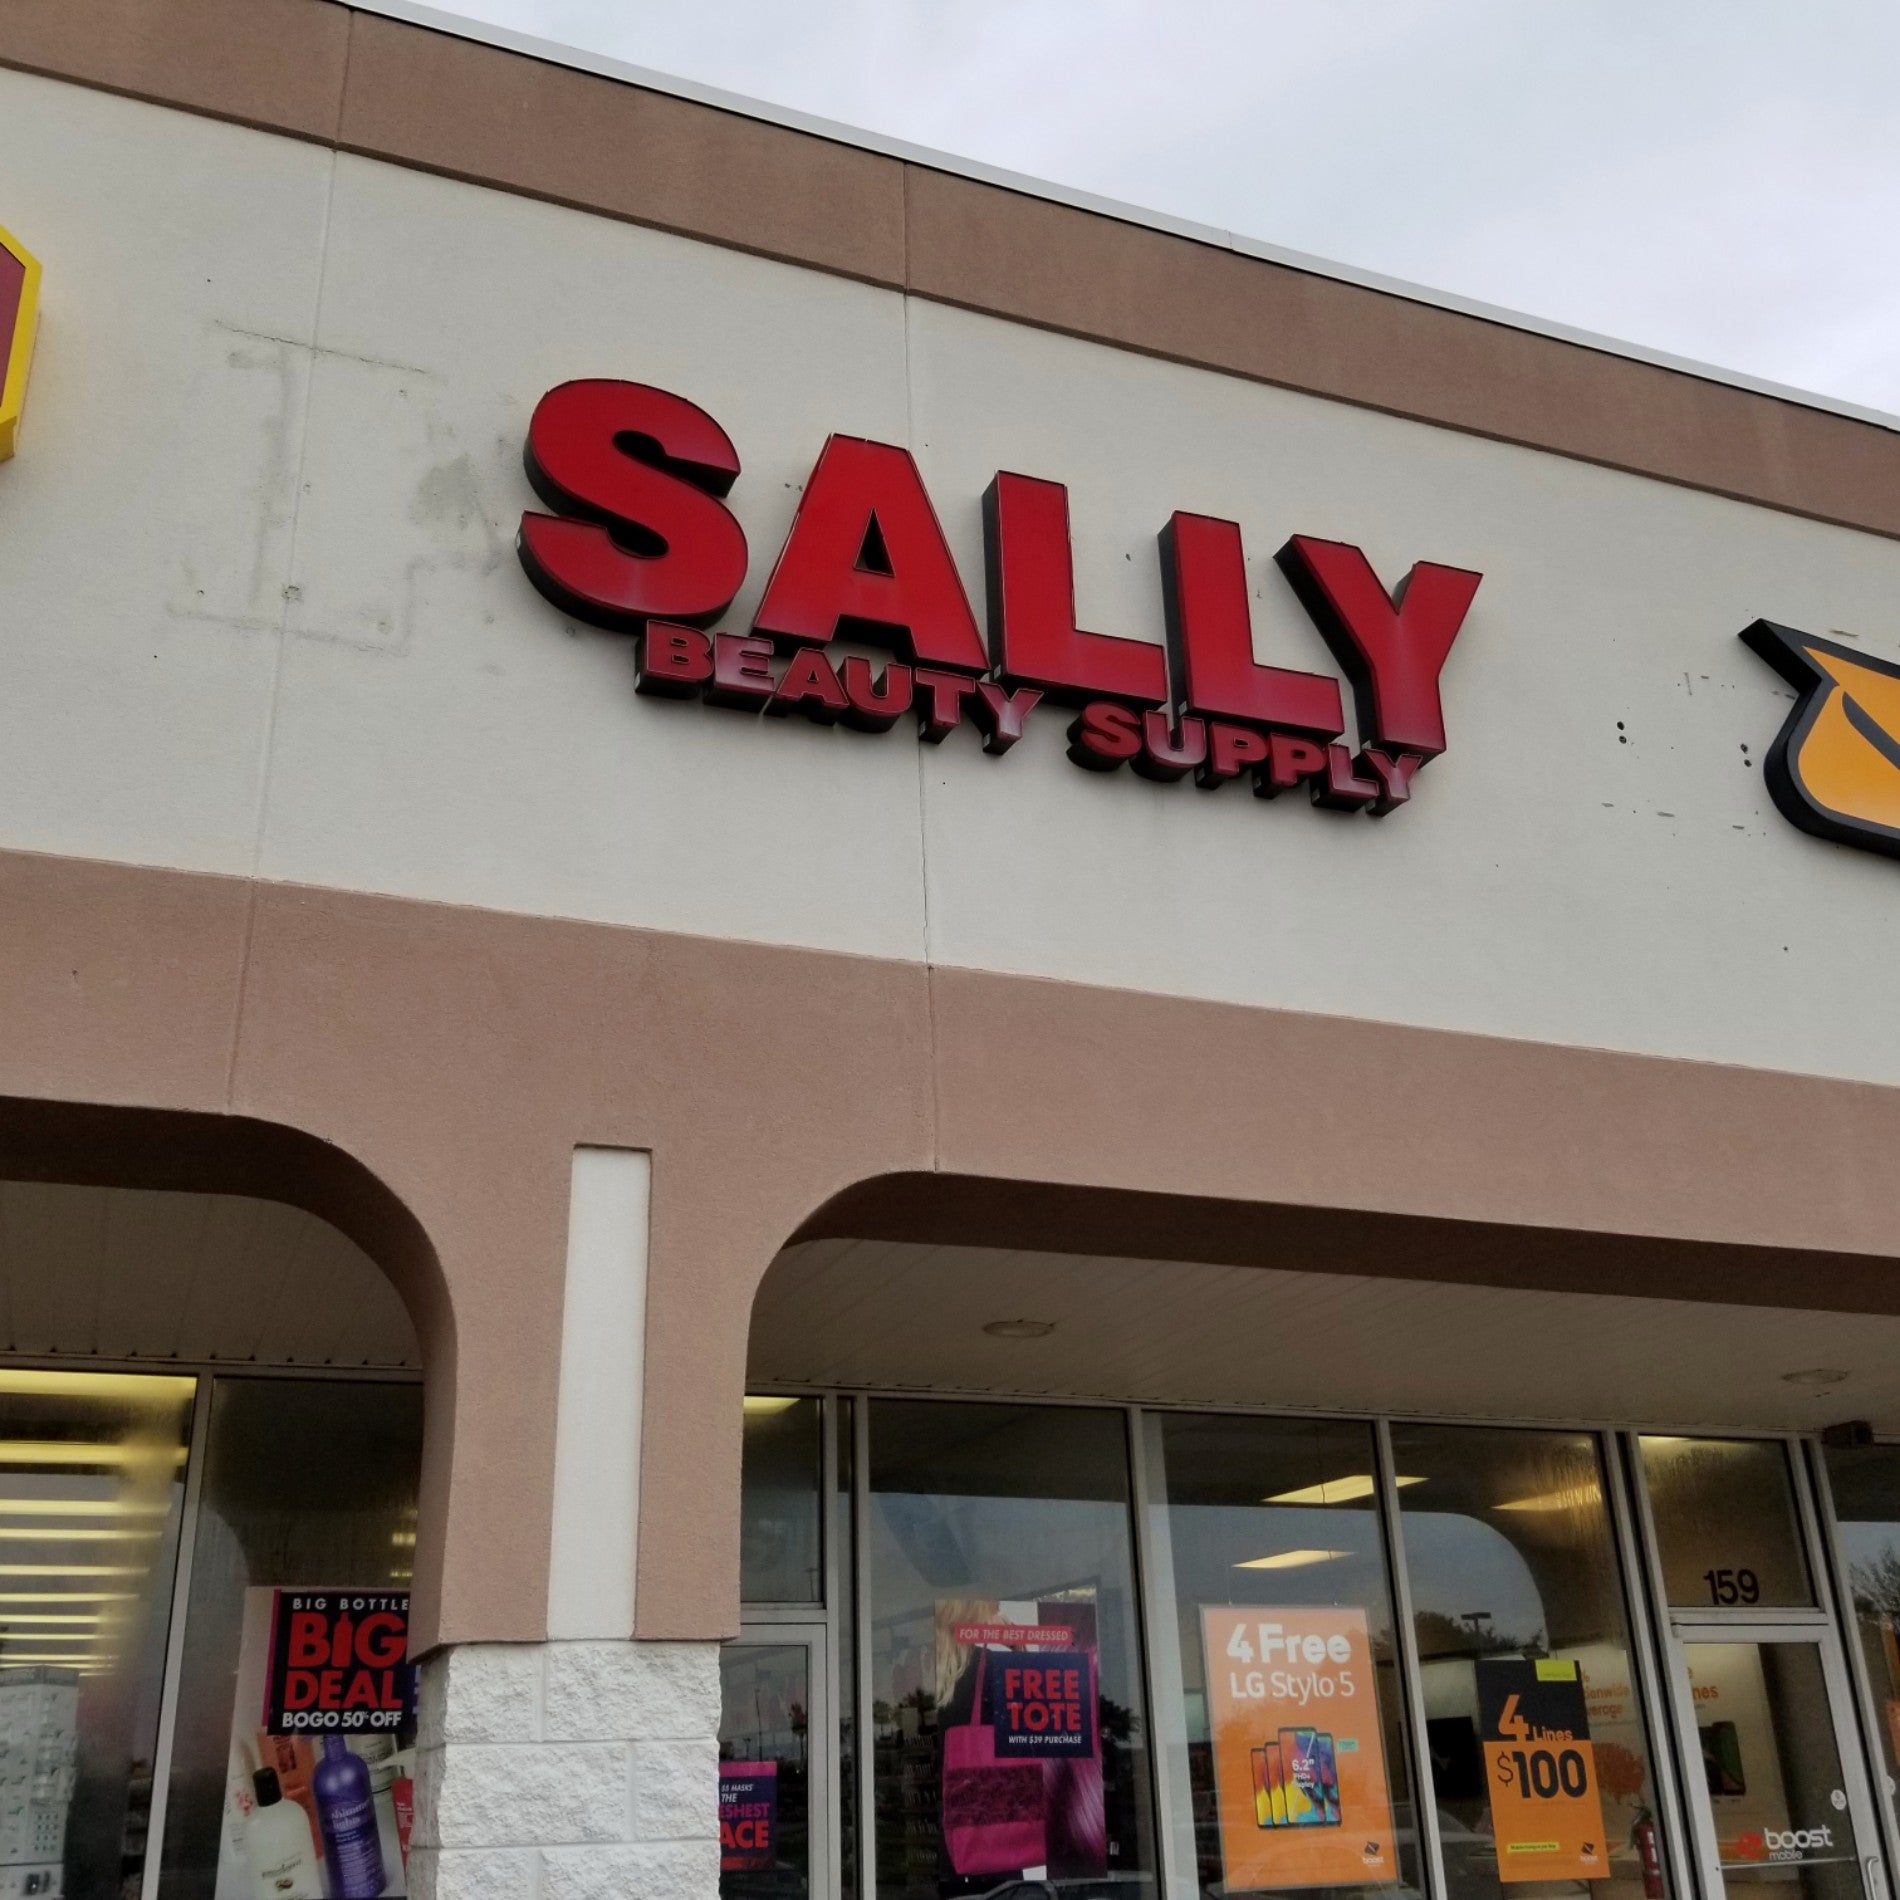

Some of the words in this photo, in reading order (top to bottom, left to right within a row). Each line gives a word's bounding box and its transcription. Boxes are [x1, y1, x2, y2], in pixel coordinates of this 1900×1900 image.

[518, 379, 1483, 760] SALLY
[636, 619, 1044, 755] BEAUTY
[1067, 701, 1421, 817] SUPPLY
[1703, 1568, 1760, 1606] 159
[292, 1597, 327, 1611] BIG
[339, 1598, 409, 1611] BOTTLE
[288, 1612, 408, 1668] BIG
[959, 1628, 980, 1640] FOR
[983, 1629, 1000, 1640] THE
[1003, 1630, 1025, 1640] BEST
[1027, 1630, 1069, 1641] DRESSED
[1226, 1623, 1254, 1663] 4
[1257, 1623, 1352, 1664] Free
[284, 1669, 404, 1710] DEAL
[1005, 1668, 1080, 1700] FREE
[1230, 1671, 1266, 1698] LG
[1271, 1671, 1334, 1706] Stylo
[1339, 1671, 1355, 1698] 5
[282, 1711, 339, 1728] BOGO
[370, 1711, 402, 1727] OFF
[1005, 1701, 1082, 1732] TOTE
[1497, 1694, 1529, 1741] 4
[1532, 1725, 1574, 1742] Lines
[1008, 1735, 1028, 1744] WITH
[1029, 1735, 1043, 1744] $39
[1044, 1736, 1082, 1744] PURCHASE
[1496, 1749, 1588, 1799] $100
[721, 1793, 738, 1803] THE
[1764, 1824, 1833, 1850] boost
[1768, 1850, 1803, 1861] mobile
